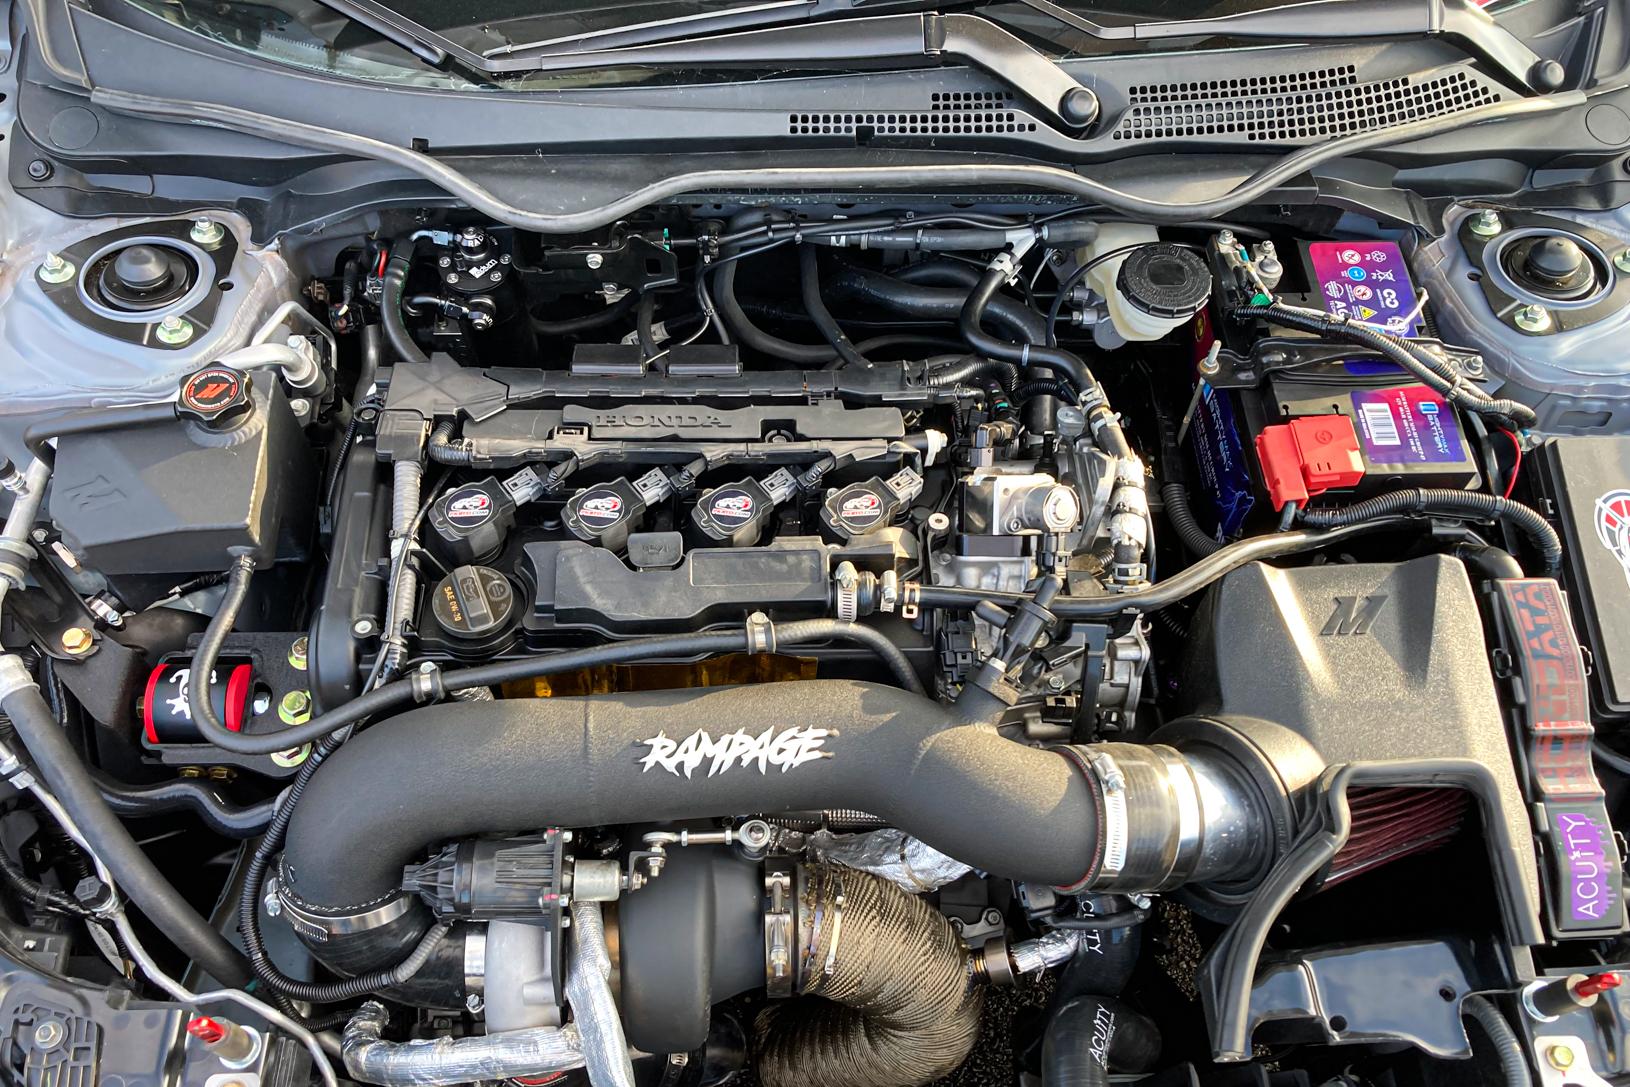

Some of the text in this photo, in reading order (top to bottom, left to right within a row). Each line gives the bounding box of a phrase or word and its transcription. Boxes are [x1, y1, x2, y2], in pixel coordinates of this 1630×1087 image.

[596, 415, 732, 428] HONDA
[444, 586, 455, 601] SAE
[637, 724, 830, 780] RAMPAGE
[1562, 815, 1599, 918] ACUITY
[1088, 1003, 1111, 1063] ACUITY
